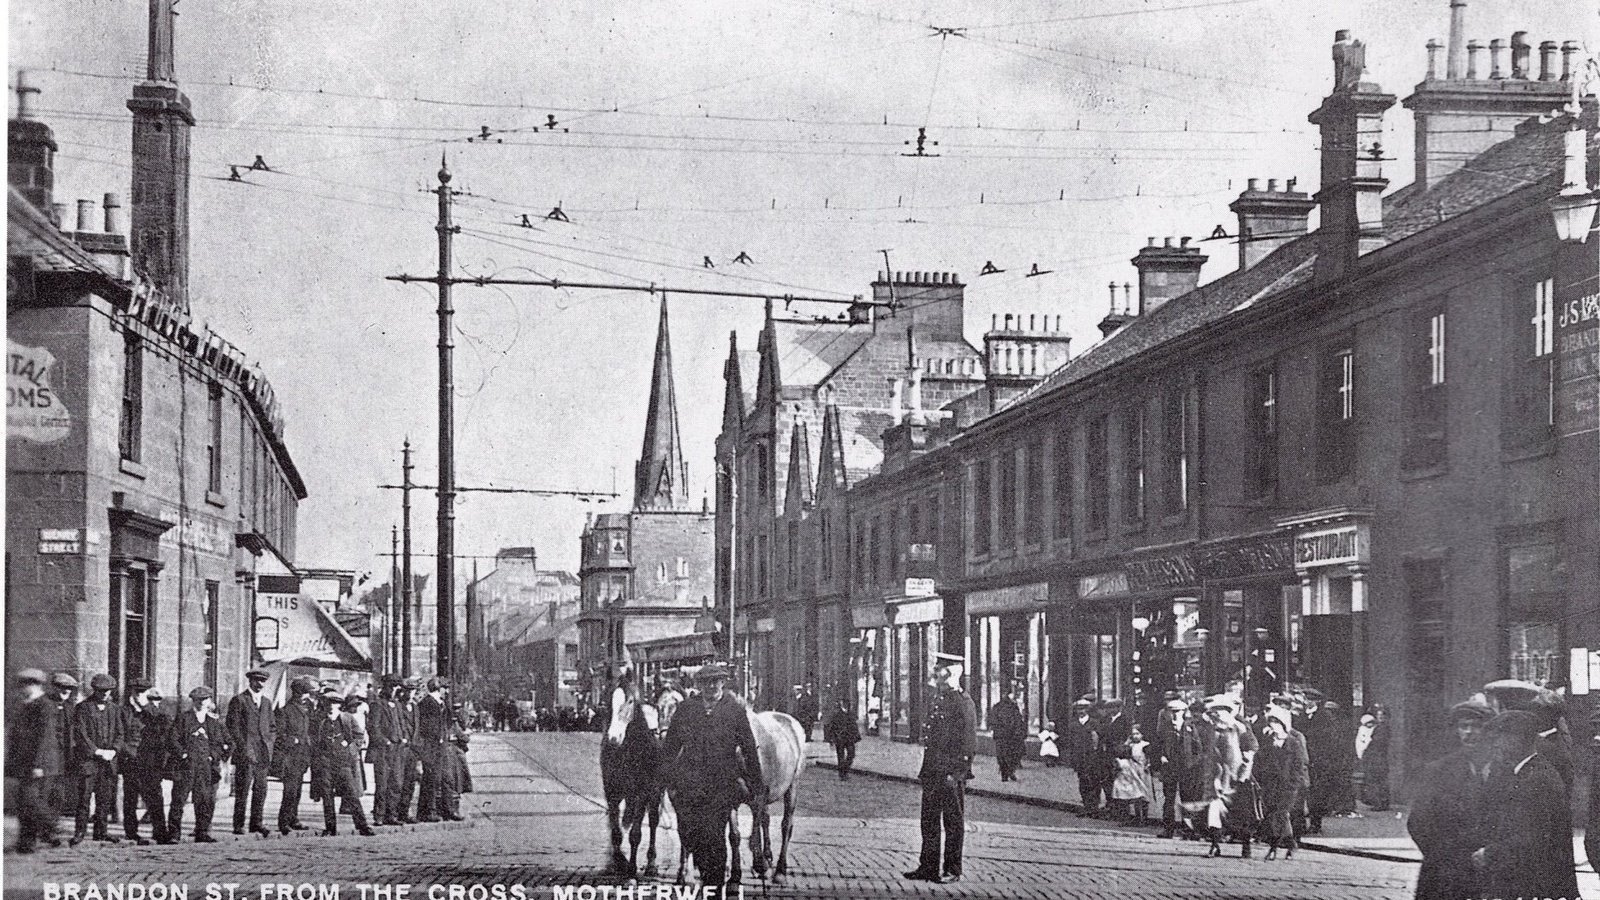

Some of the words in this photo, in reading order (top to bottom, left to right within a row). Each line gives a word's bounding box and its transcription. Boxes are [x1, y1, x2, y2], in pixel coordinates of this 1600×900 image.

[6, 351, 46, 387] TAL
[1295, 530, 1358, 563] RESTAURANT
[266, 595, 298, 610] THIS
